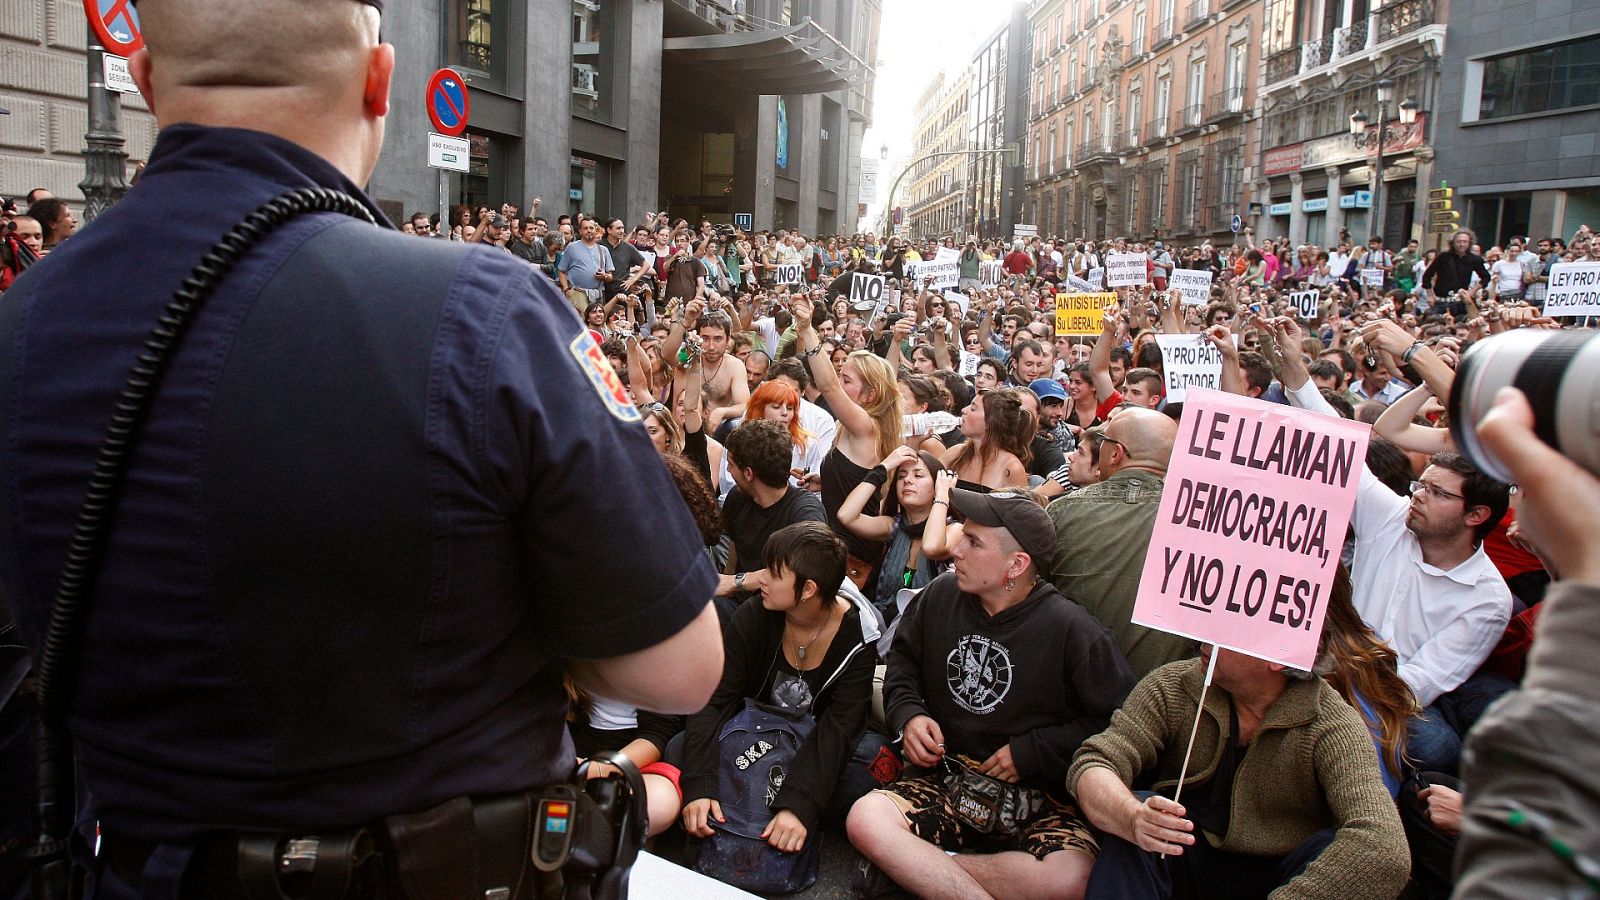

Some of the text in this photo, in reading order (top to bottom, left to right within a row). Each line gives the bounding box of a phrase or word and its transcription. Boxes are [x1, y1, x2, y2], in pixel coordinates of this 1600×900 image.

[111, 63, 125, 73] ZONA
[109, 73, 133, 84] SEGURID
[443, 143, 467, 153] EXCLUSIVO
[778, 265, 801, 283] NO!
[918, 266, 926, 275] LEY
[927, 264, 937, 274] PRO
[851, 275, 883, 301] NO
[1172, 274, 1181, 283] LEY
[1181, 275, 1192, 285] PRO
[1552, 272, 1571, 287] LEY
[1573, 271, 1595, 286] PRO
[1289, 293, 1318, 317] NO!
[1057, 317, 1066, 330] Su
[1067, 317, 1096, 330] LIBERAL
[1174, 346, 1196, 365] PRO
[1188, 409, 1356, 488] LE LLAMAN
[1171, 478, 1329, 568] DEMOCRACIA,
[1160, 546, 1321, 631] Y NO LO ES!
[735, 740, 774, 770] SKA
